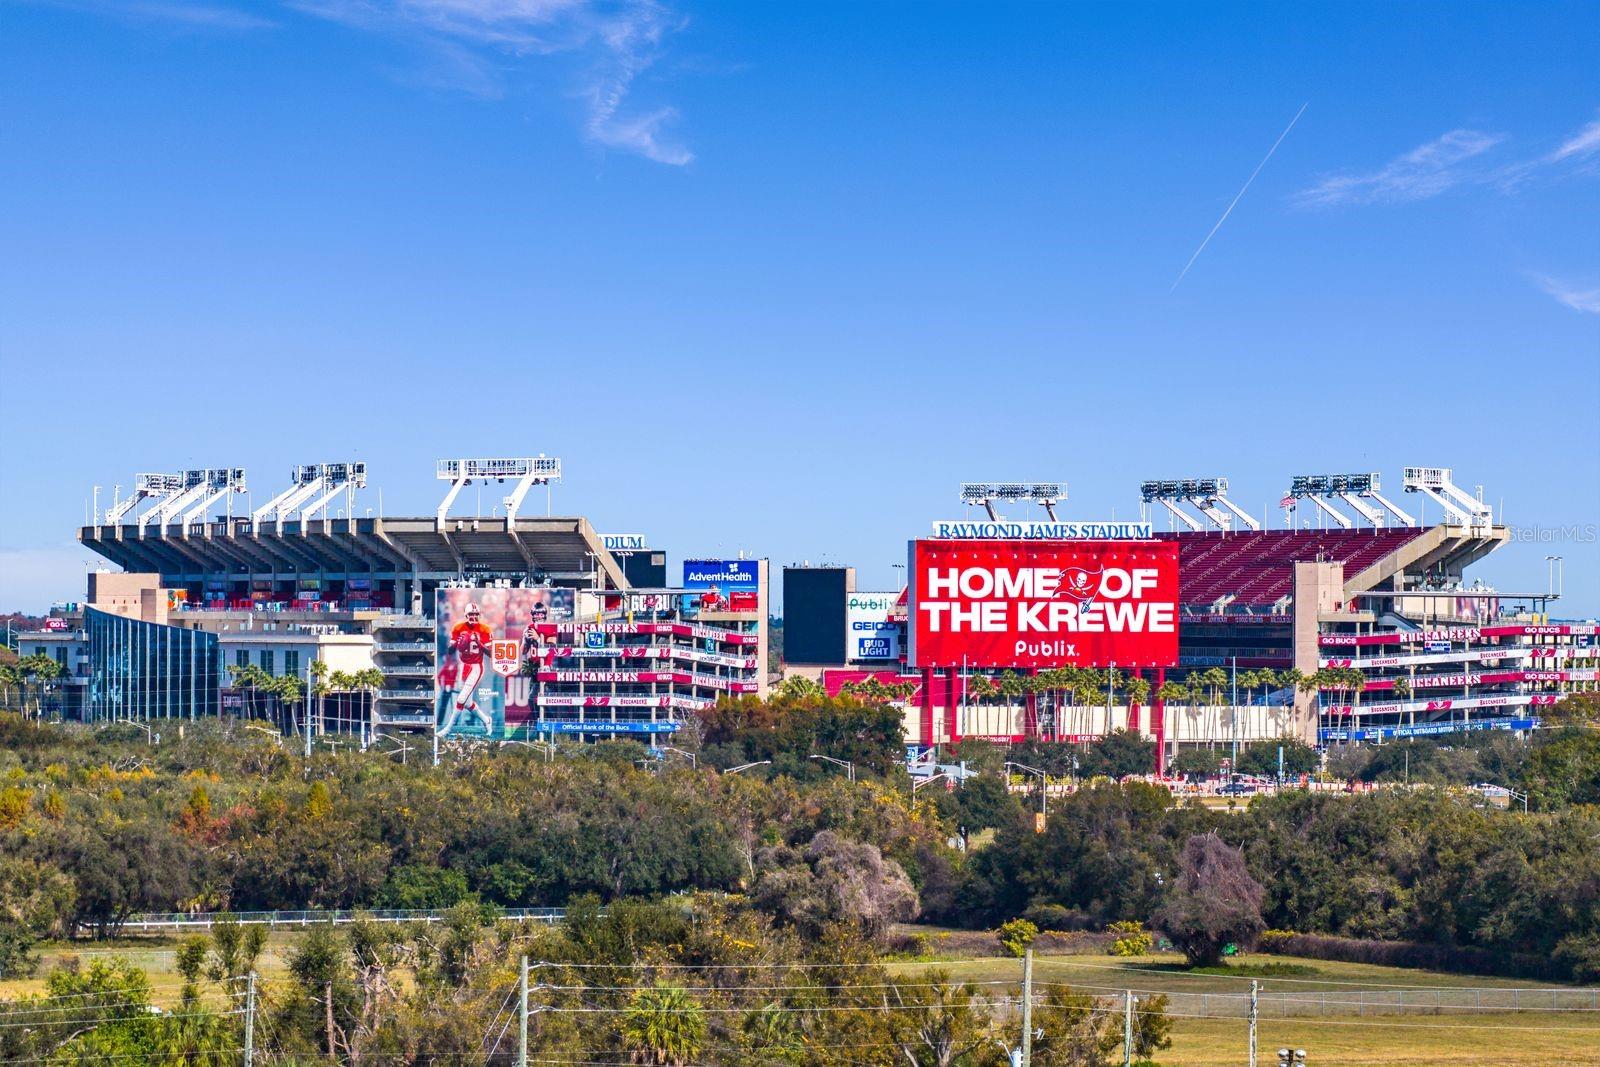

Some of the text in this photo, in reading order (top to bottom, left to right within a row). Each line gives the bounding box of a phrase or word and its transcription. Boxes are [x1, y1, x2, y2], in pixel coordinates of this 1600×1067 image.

[939, 523, 1150, 539] RAYMOND JAMES STADIUM
[688, 571, 752, 582] AdventHealth
[928, 566, 1159, 599] HOME OF
[919, 601, 1175, 633] THE KREWE
[556, 623, 639, 634] BUCCANEERS
[852, 621, 897, 631] GEICO
[1538, 626, 1560, 634] BUCS
[1400, 628, 1481, 643] BUCCANEERS
[863, 639, 885, 648] BUD
[1335, 637, 1357, 645] BUCS
[494, 642, 517, 660] 50
[860, 647, 889, 656] LIGHT
[1480, 651, 1508, 660] BUCCANEERS
[1371, 658, 1398, 666] BUCCANEERS
[556, 672, 639, 682] BUCCANEERS
[1406, 674, 1482, 688] UCCANEERS
[1480, 697, 1507, 706] BUCCANEERS
[1371, 705, 1398, 713] BUCCANEERS
[562, 723, 582, 731] Official
